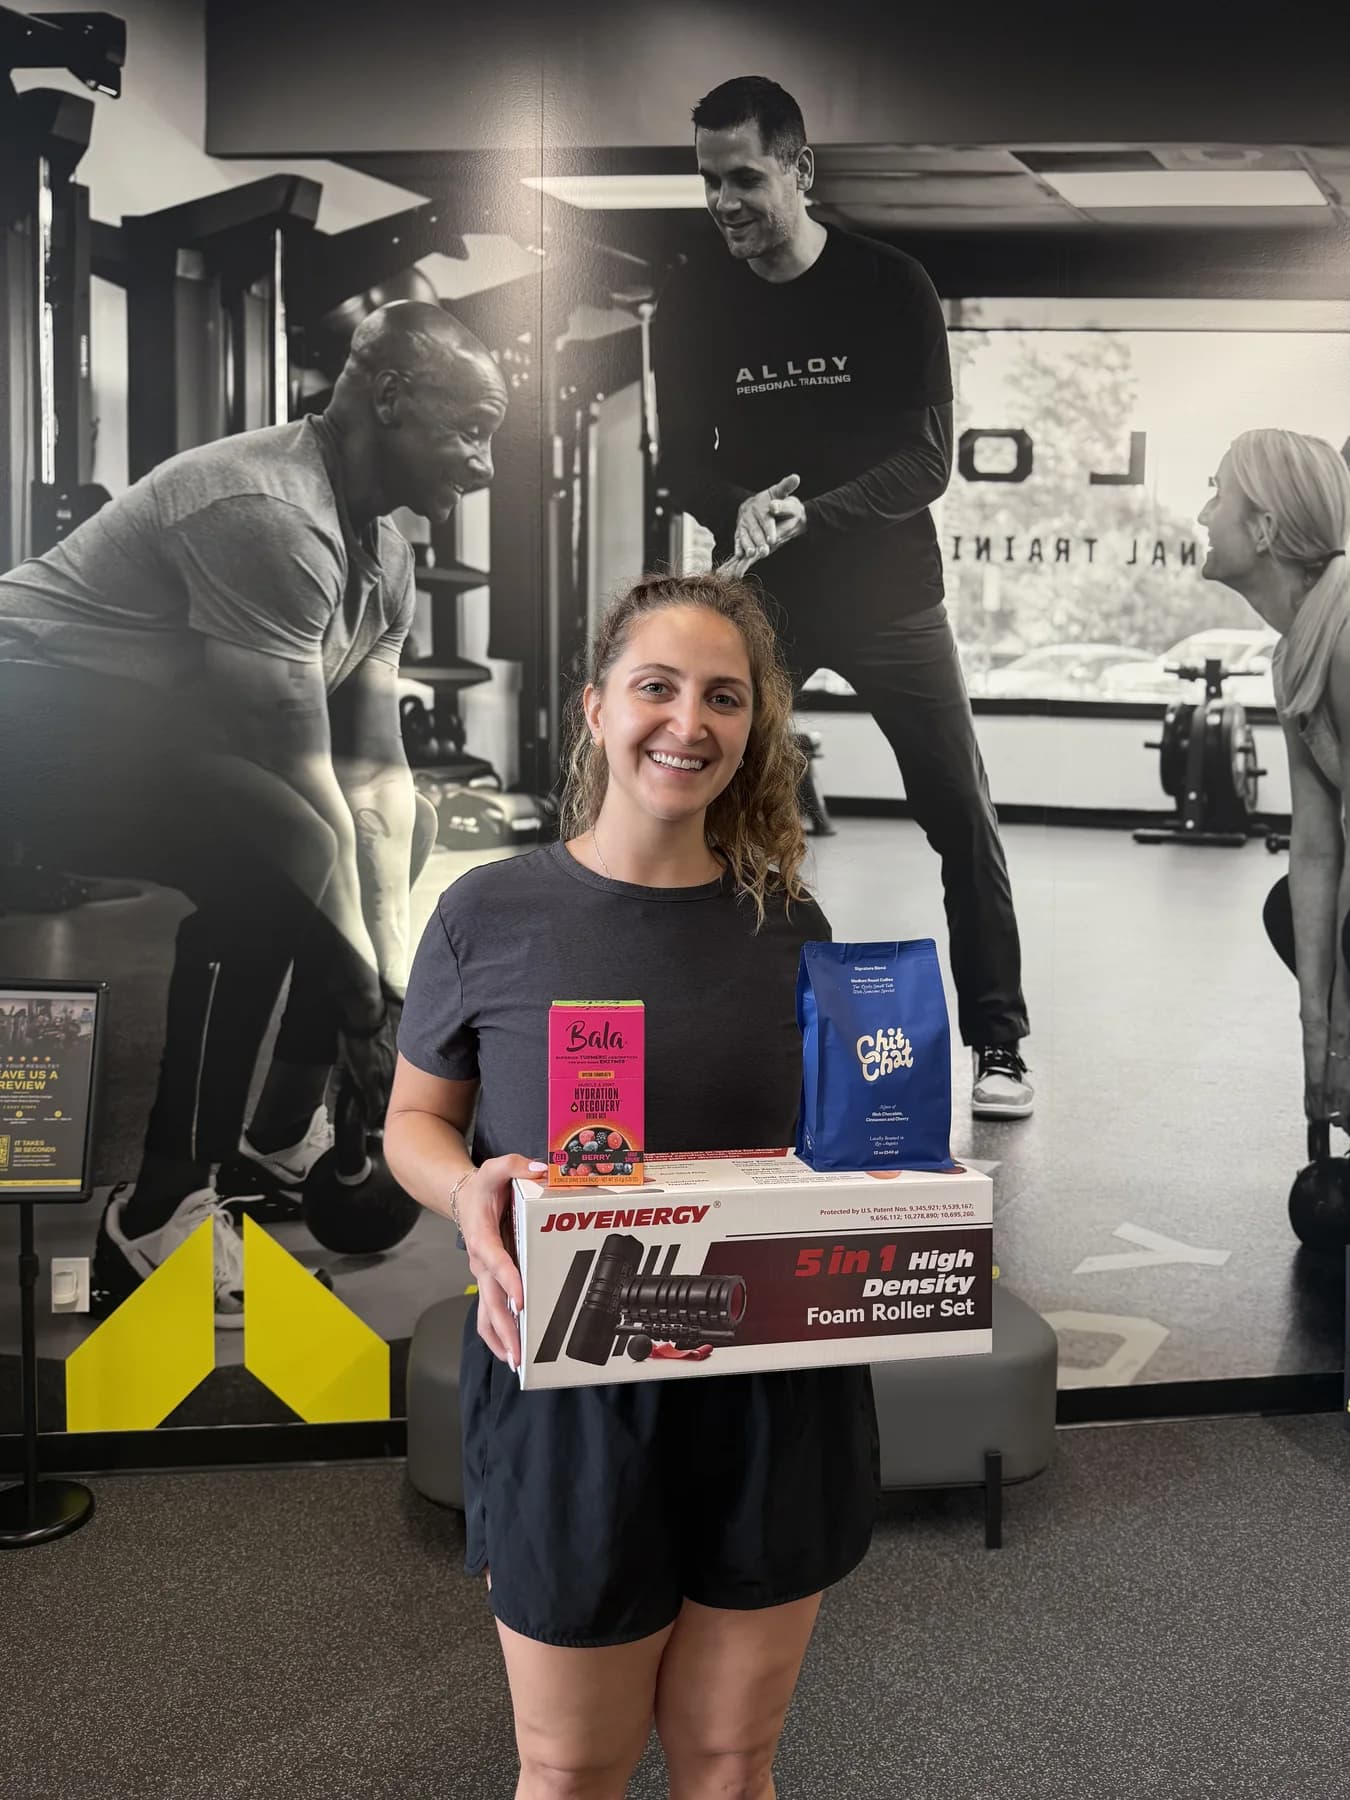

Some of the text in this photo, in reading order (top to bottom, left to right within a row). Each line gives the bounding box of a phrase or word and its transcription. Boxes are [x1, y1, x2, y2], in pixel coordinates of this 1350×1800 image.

[735, 355, 849, 384] ALLOY
[736, 374, 852, 396] PERSONAL TRAINING
[565, 1020, 624, 1053] Bala
[856, 1027, 907, 1064] Chit
[861, 1038, 914, 1082] Chat
[0, 1080, 46, 1090] REVIEW
[29, 1070, 47, 1080] US
[49, 1070, 59, 1080] A
[574, 1087, 619, 1100] HYDRATION
[579, 1099, 620, 1112] RECOVERY
[582, 1153, 611, 1161] BERRY
[539, 1204, 712, 1233] JOYENERGY
[820, 1208, 851, 1216] Protected
[851, 1207, 860, 1216] by
[894, 1205, 908, 1213] Nos.
[794, 1244, 975, 1277] 5 in 1 High
[862, 1274, 976, 1298] Density
[807, 1298, 975, 1326] Foam Roller Set
